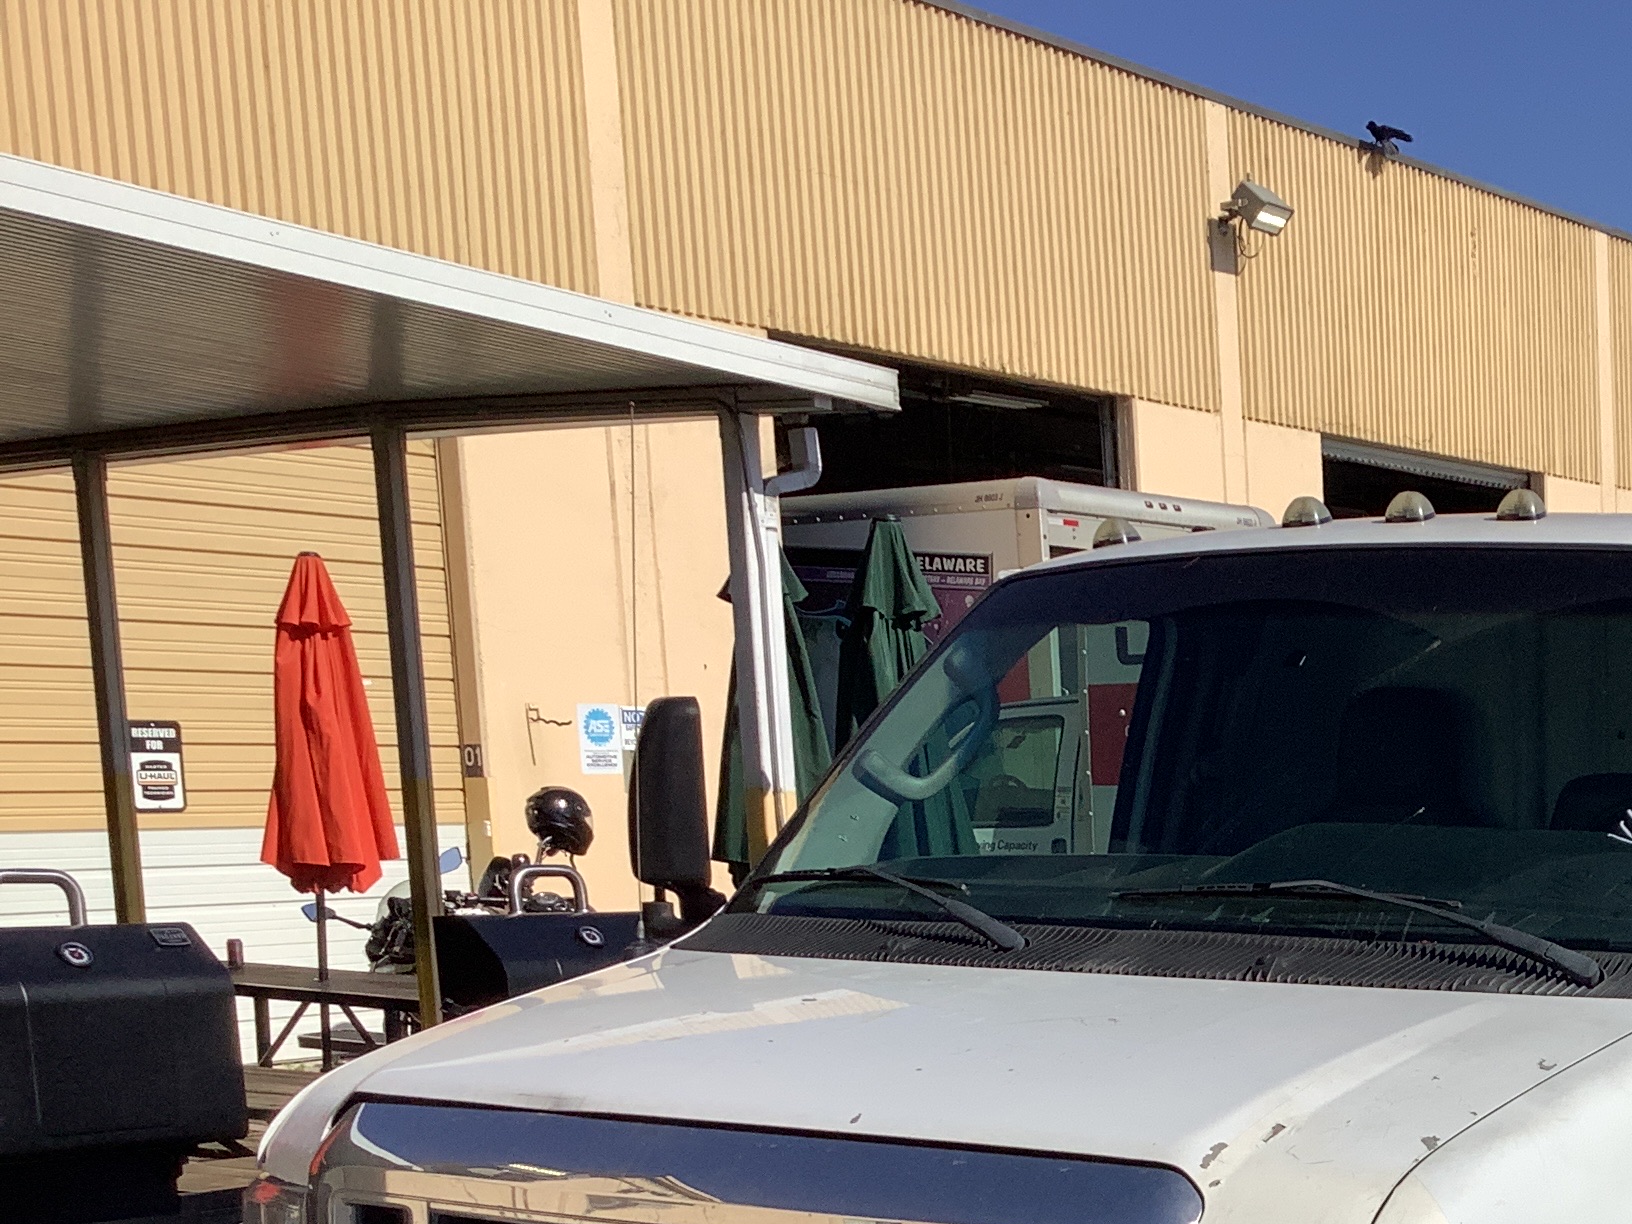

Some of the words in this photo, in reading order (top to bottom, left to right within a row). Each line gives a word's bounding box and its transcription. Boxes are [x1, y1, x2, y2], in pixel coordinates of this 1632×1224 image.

[916, 556, 985, 572] ELAWARE
[131, 727, 176, 738] RESERVED
[145, 740, 163, 750] FOR
[139, 772, 175, 780] U-HAUL
[997, 839, 1038, 852] Capacity
